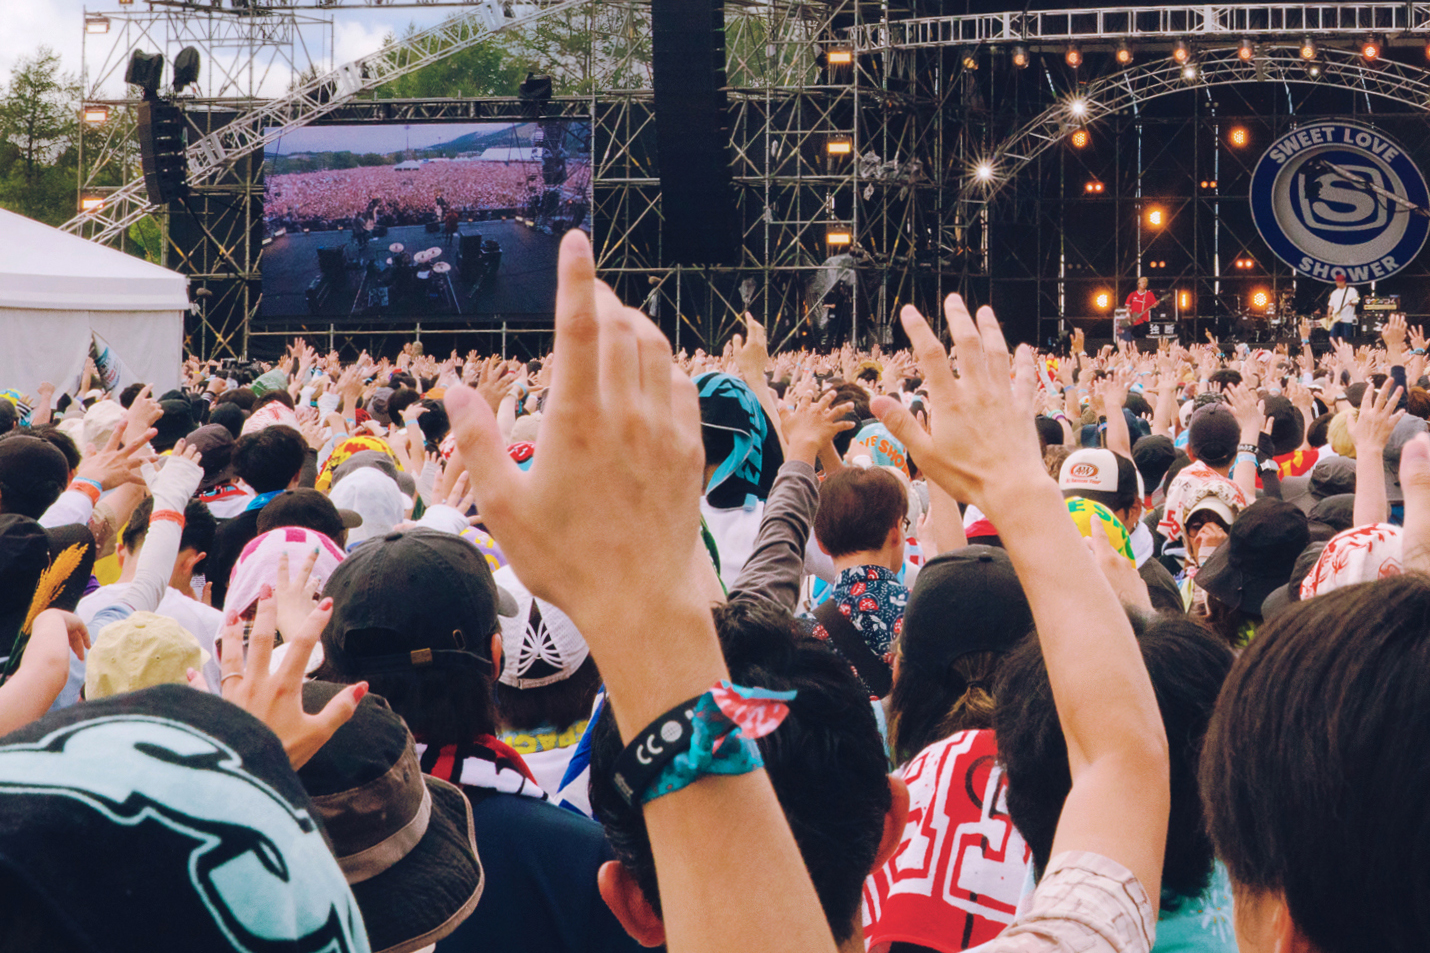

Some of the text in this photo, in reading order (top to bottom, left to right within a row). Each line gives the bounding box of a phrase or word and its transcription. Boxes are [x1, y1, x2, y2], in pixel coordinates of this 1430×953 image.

[1269, 127, 1400, 164] SWEET LOVE
[1298, 256, 1400, 283] SHOWER
